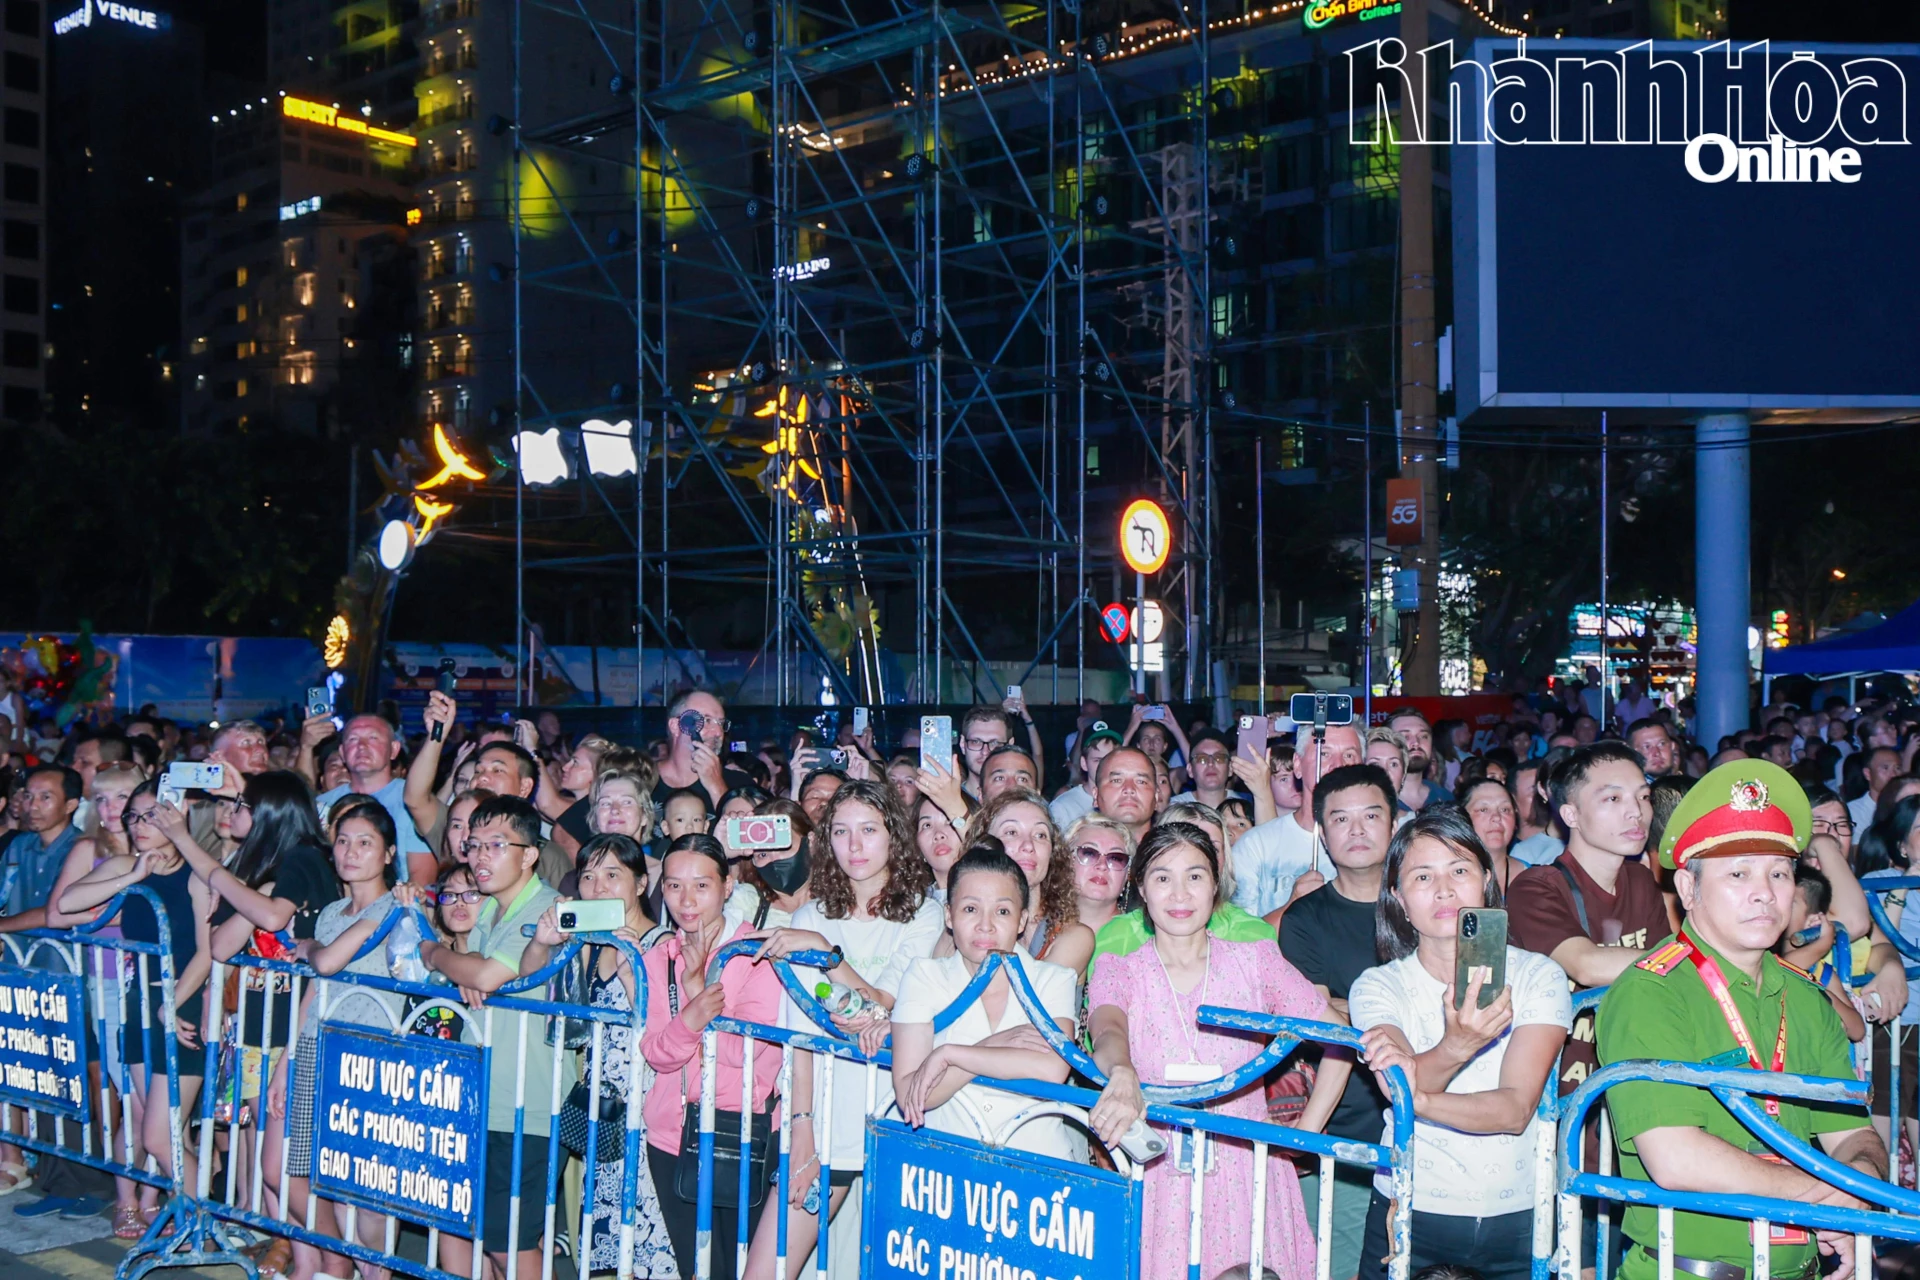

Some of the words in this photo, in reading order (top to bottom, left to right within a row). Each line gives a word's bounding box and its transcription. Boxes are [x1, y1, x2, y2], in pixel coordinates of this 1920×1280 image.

[97, 0, 157, 29] VENUE
[1391, 504, 1418, 525] 5G
[0, 985, 12, 1013] HU
[14, 985, 39, 1022] VỰC
[40, 983, 68, 1023] CẤM
[51, 1033, 76, 1066] TIỆN
[339, 1052, 375, 1093] KHU
[380, 1060, 415, 1106] VỰC
[419, 1059, 462, 1112] CẤM
[329, 1098, 359, 1136] CÁC
[363, 1110, 425, 1153] PHƯƠNG
[429, 1122, 468, 1166] TIỆN
[319, 1147, 350, 1181] GIAO
[353, 1154, 397, 1195] THÔNG
[400, 1164, 449, 1210] ĐƯỜNG
[451, 1178, 472, 1223] BỘ
[901, 1163, 953, 1221] KHU
[964, 1180, 1019, 1243] VỰC
[1029, 1186, 1095, 1260] CẤM
[886, 1226, 930, 1277] CÁC
